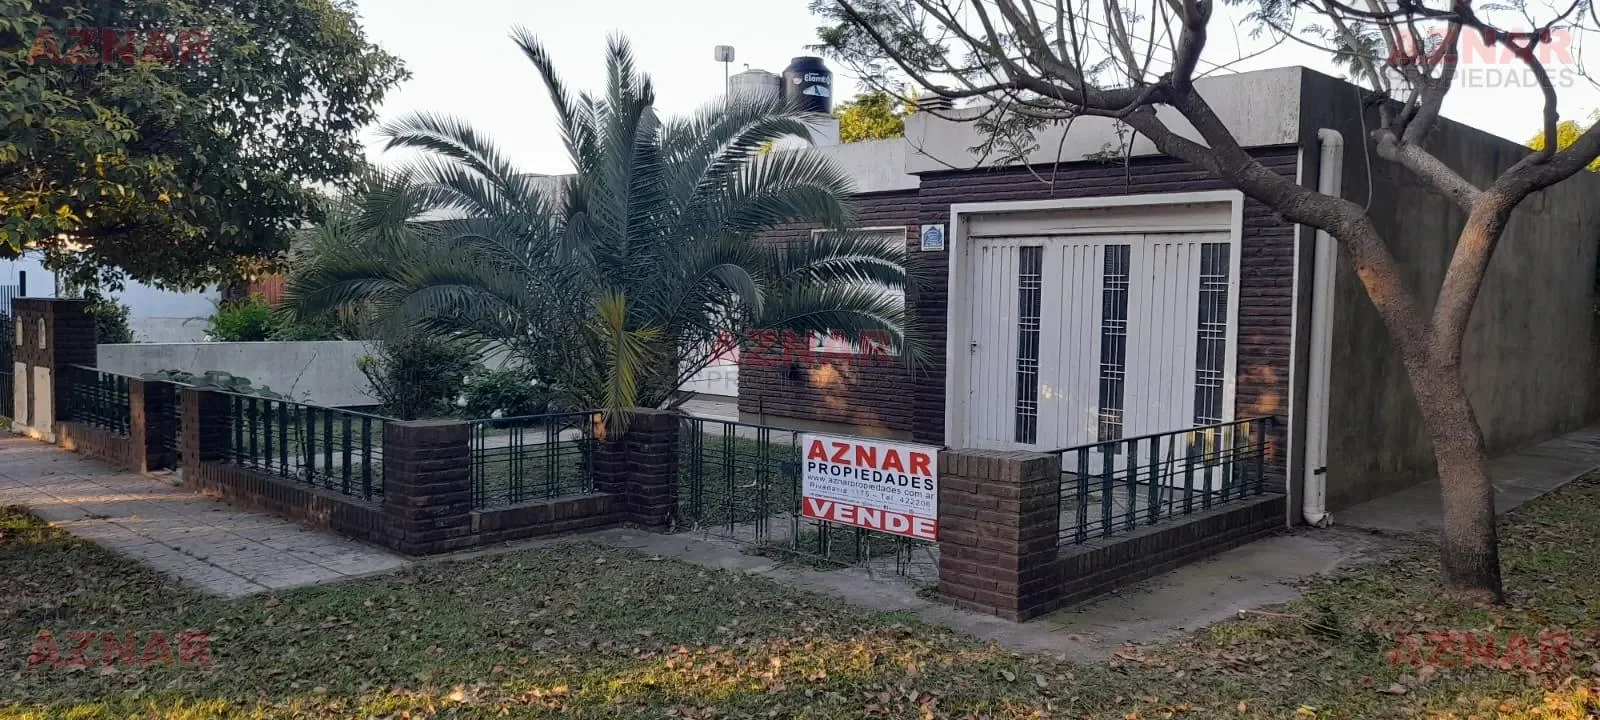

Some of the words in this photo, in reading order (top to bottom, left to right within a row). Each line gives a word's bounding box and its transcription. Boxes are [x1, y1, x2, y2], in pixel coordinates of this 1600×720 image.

[807, 440, 933, 477] AZNAR
[807, 461, 934, 491] PROPIEDADES
[808, 498, 936, 539] VENDE
